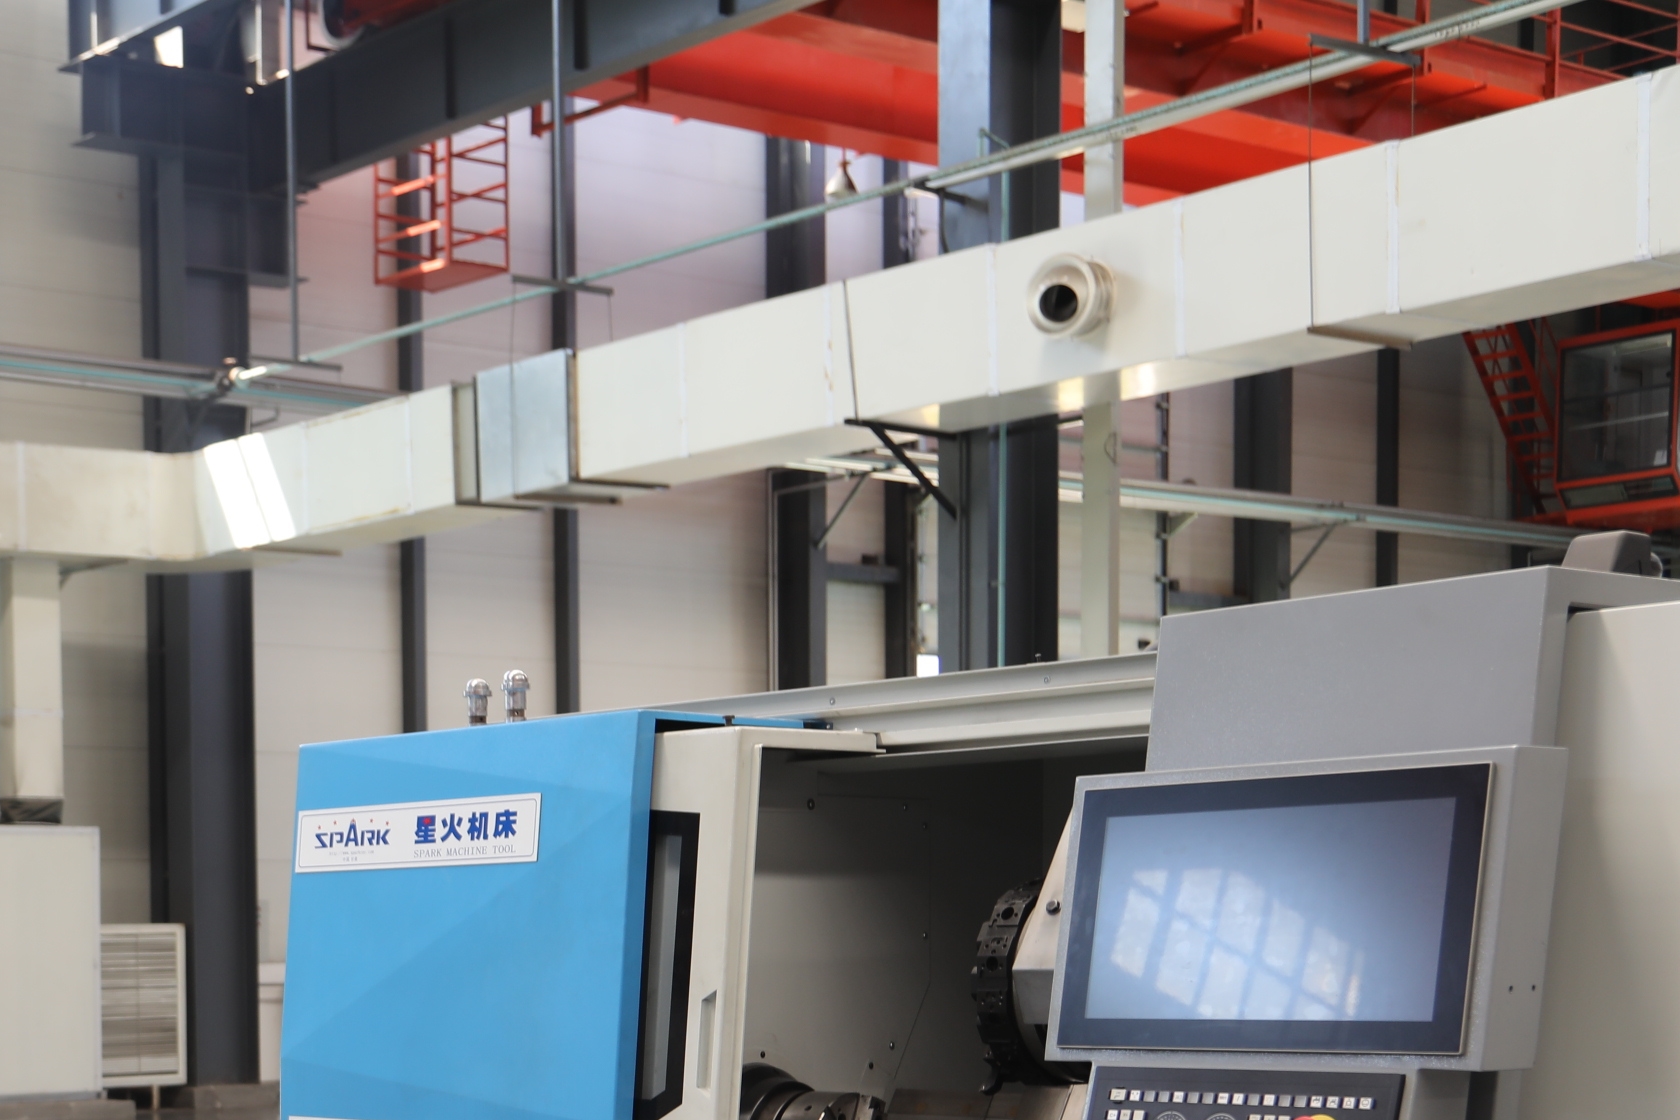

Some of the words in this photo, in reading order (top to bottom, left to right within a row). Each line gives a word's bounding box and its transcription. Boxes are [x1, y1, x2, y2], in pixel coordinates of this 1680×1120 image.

[314, 821, 391, 849] SPARK
[414, 809, 518, 845] 星火机床
[413, 848, 442, 859] SPARK
[446, 845, 488, 857] MACHINE
[492, 844, 517, 855] TOOL
